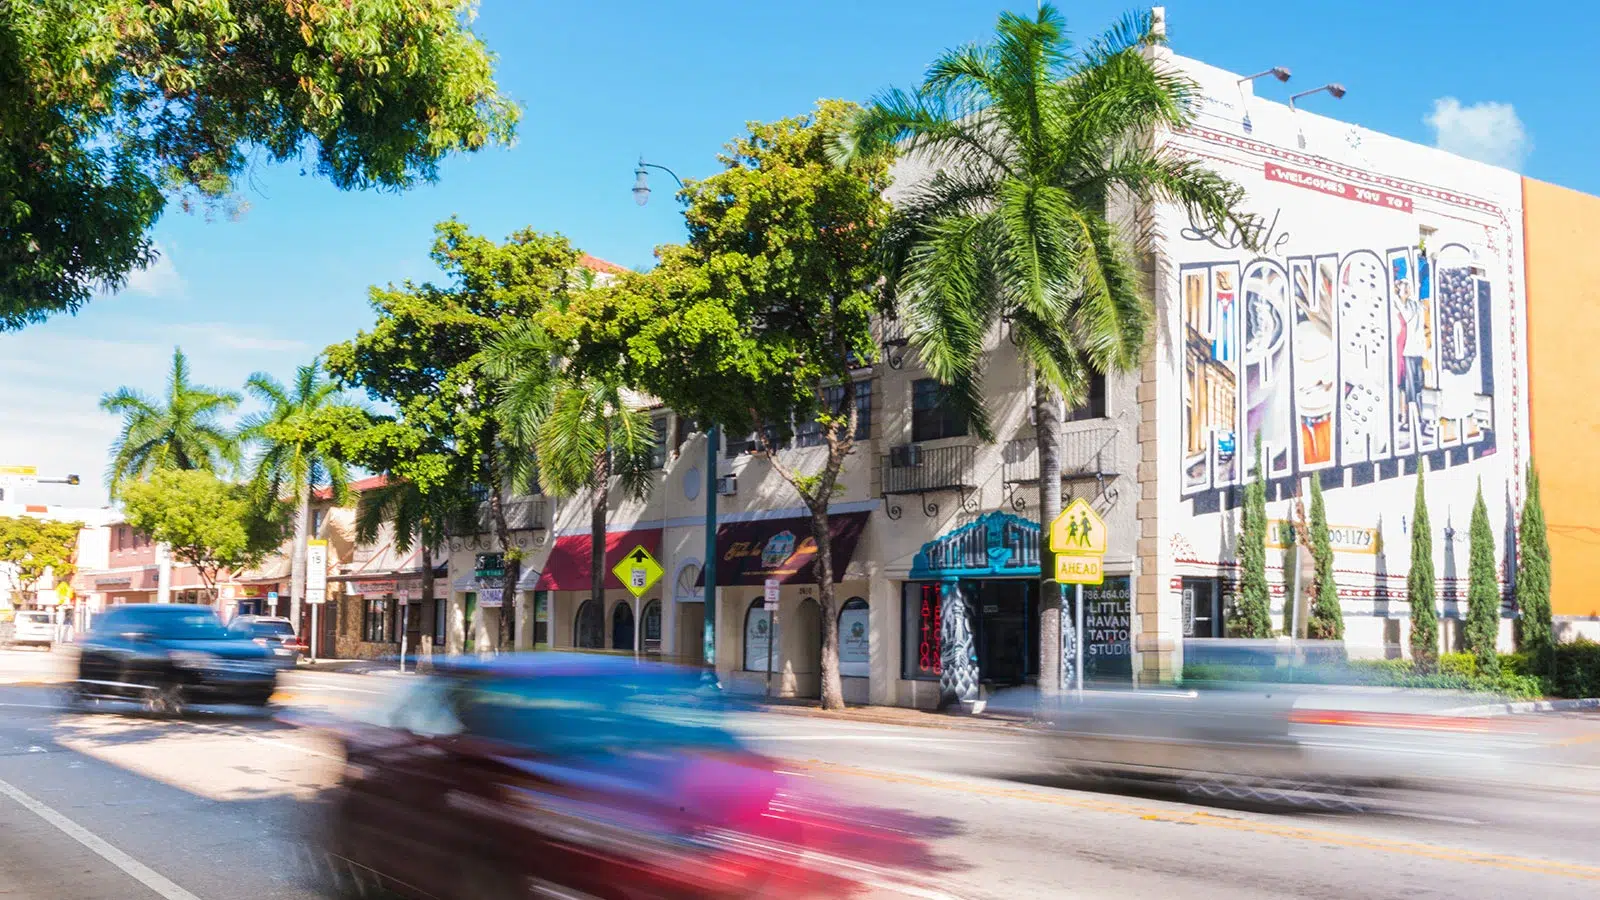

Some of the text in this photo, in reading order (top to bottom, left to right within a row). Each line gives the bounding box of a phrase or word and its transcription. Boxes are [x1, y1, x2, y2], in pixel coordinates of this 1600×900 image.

[1275, 168, 1404, 208] WELCOMES YOU TO
[1179, 242, 1496, 502] HAVANA
[926, 523, 988, 569] TATTOO
[1060, 562, 1098, 575] AHEAD
[633, 578, 644, 586] 15
[1089, 602, 1131, 613] LITTLE
[920, 585, 931, 672] TATTOO
[1088, 629, 1131, 641] TATTO
